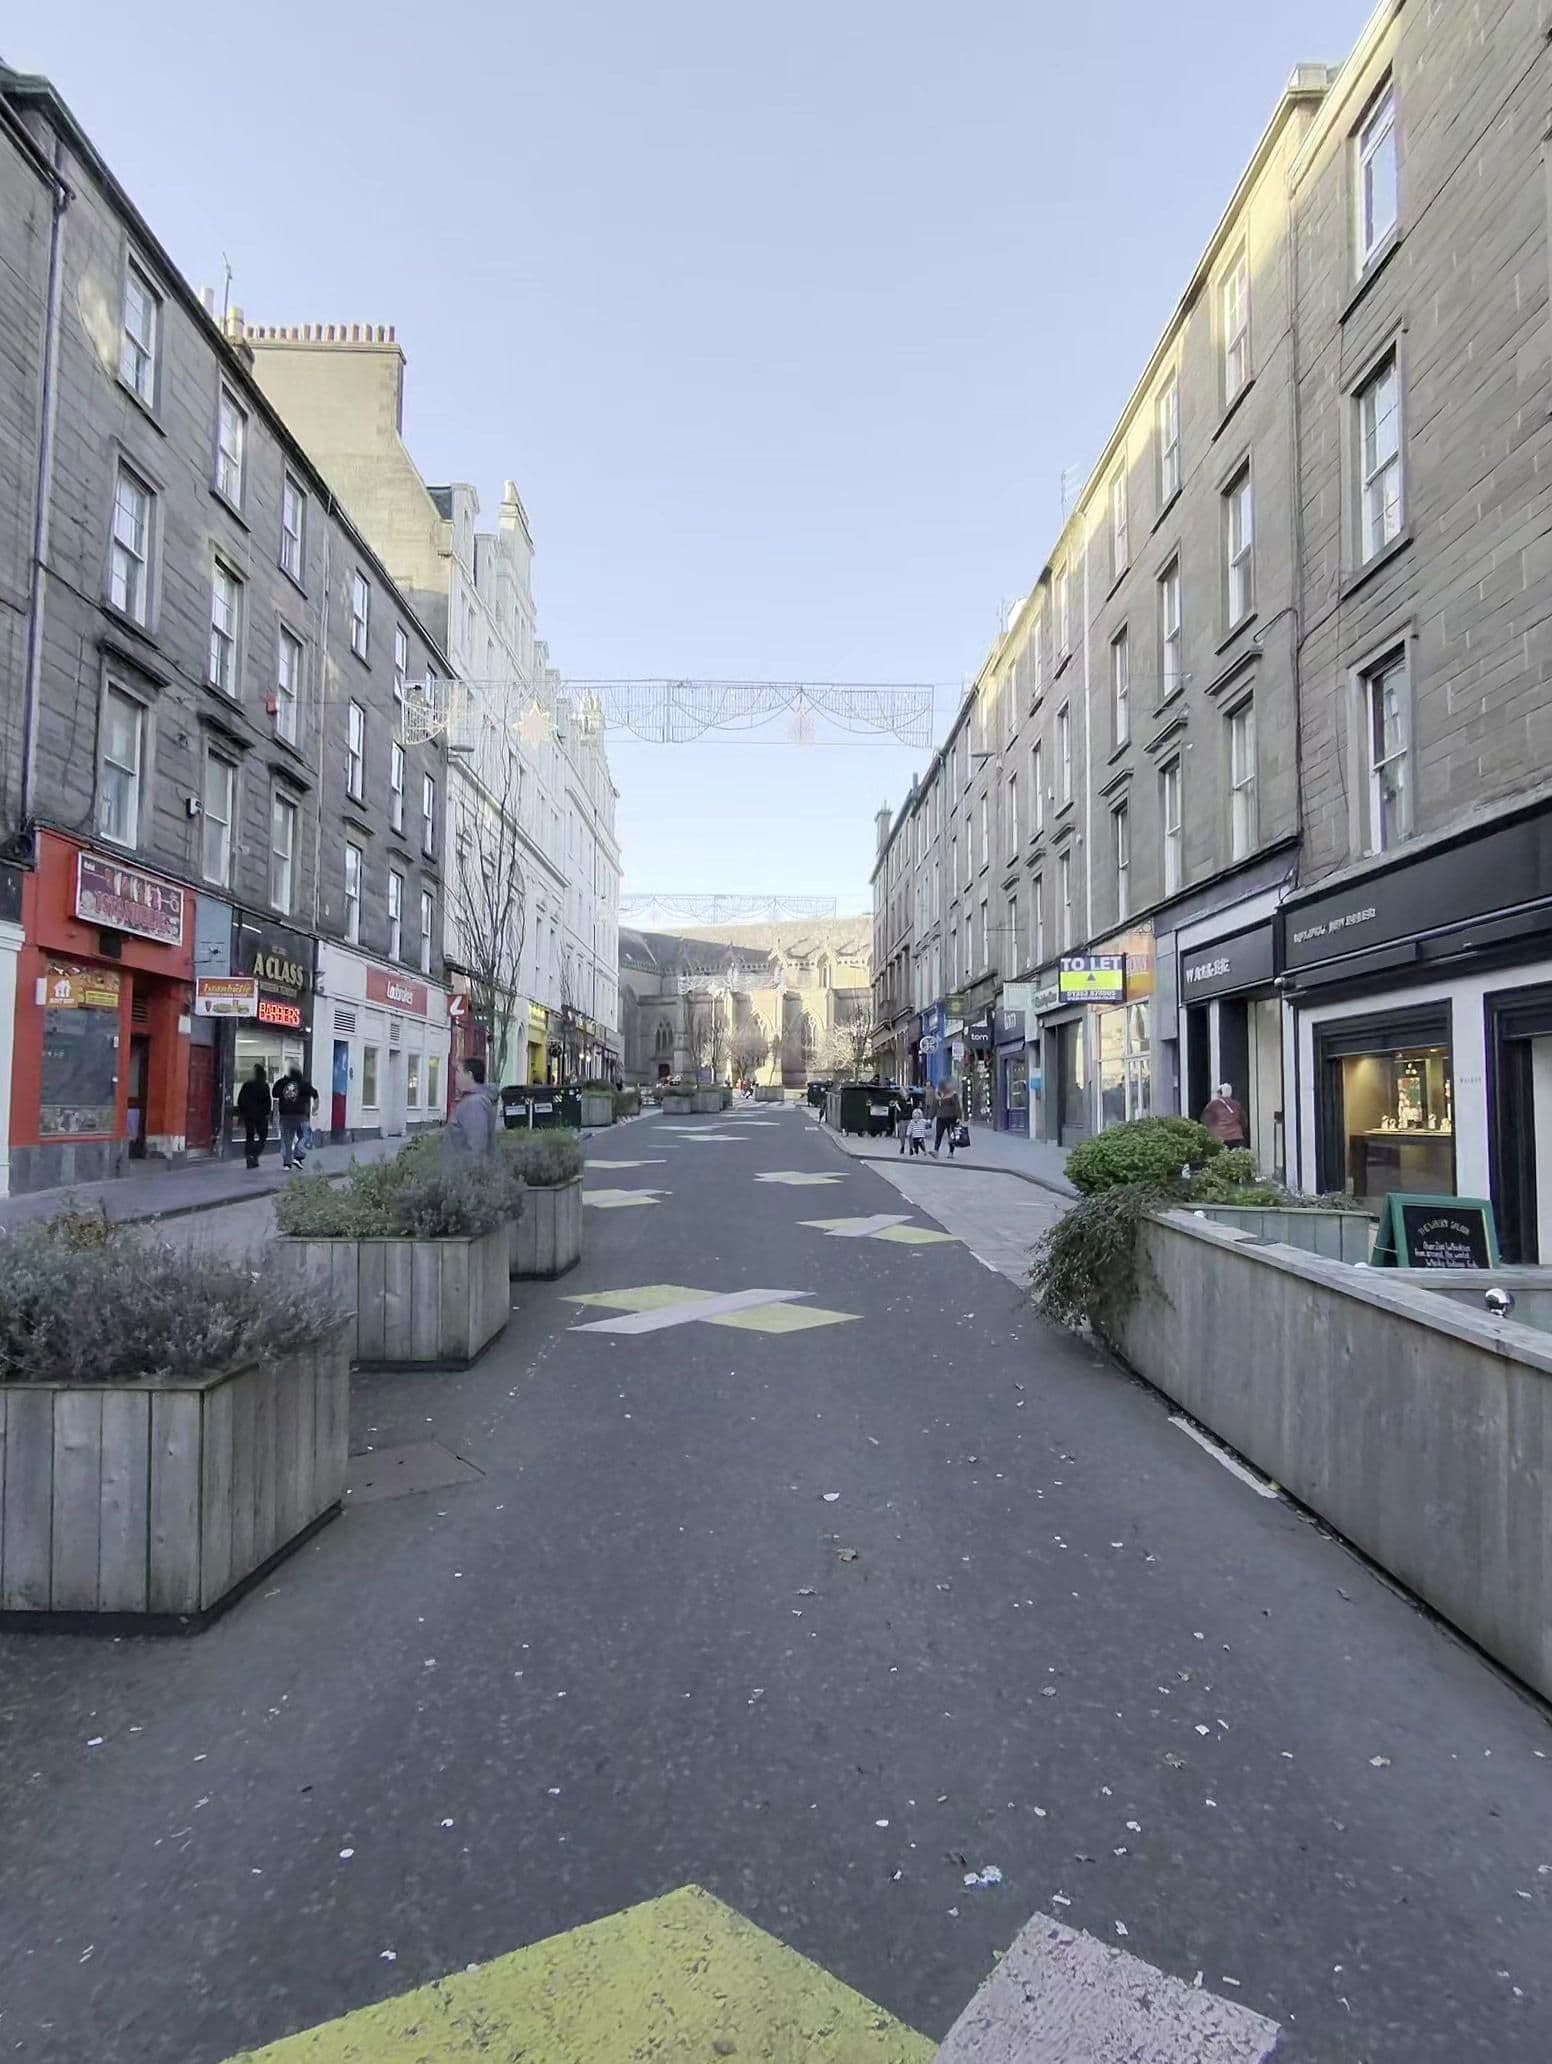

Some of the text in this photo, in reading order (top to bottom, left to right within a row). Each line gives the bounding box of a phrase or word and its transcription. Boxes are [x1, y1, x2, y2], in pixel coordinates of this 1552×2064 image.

[1061, 957, 1084, 970] TO
[1090, 957, 1121, 970] LET
[254, 952, 265, 976] A
[266, 956, 304, 990] CLASS
[971, 1033, 989, 1041] tom
